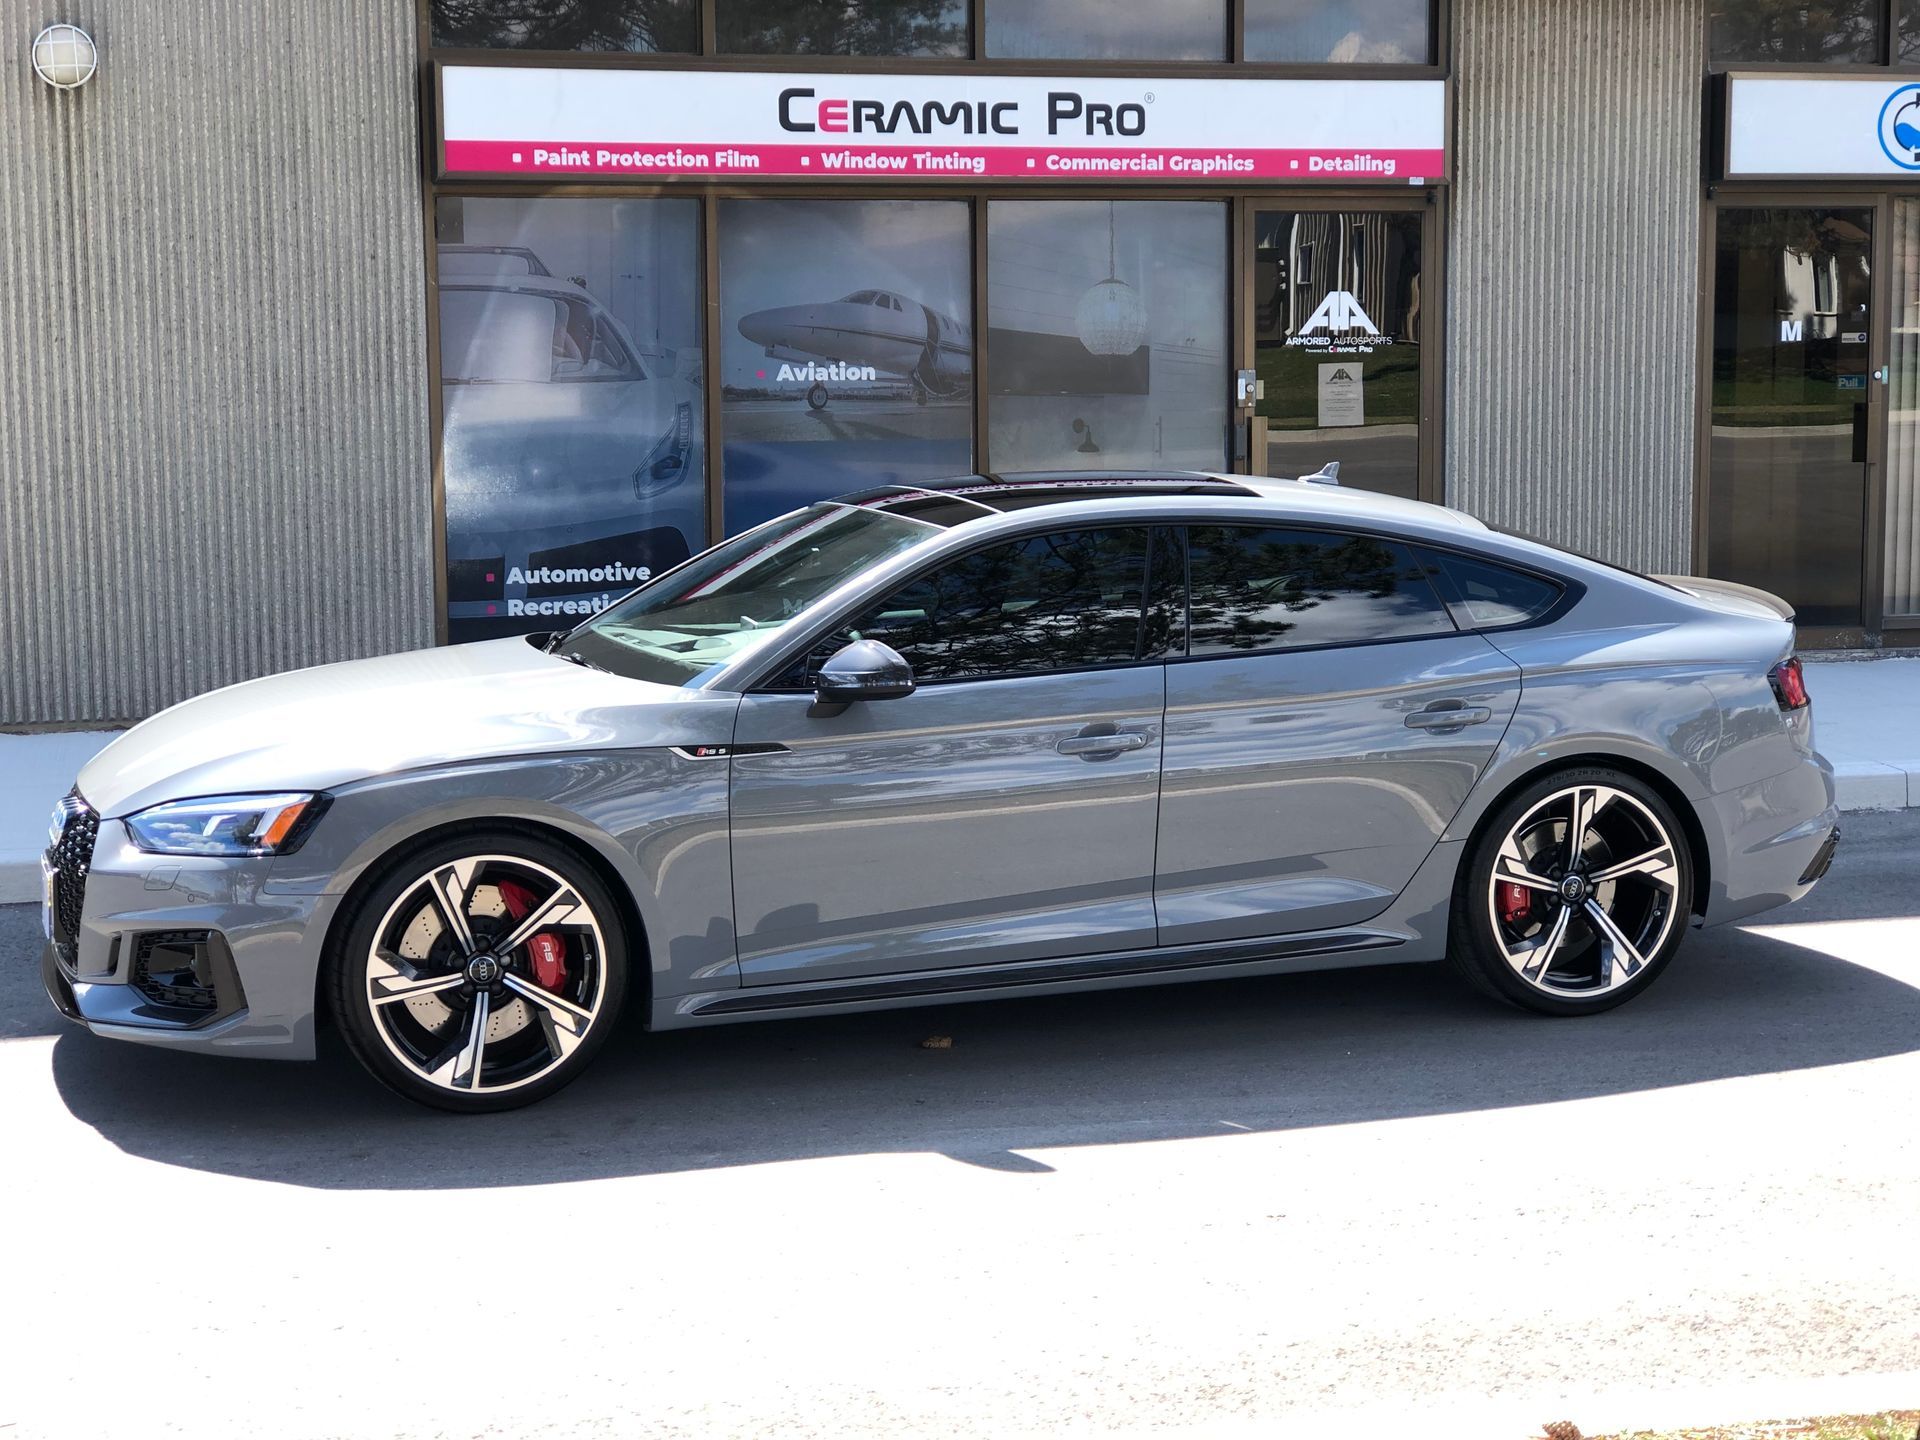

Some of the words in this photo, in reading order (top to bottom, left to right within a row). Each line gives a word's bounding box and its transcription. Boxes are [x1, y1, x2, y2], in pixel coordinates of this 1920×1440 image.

[779, 88, 1018, 134] CERAMIC
[1047, 91, 1146, 137] PRO
[533, 149, 590, 167] Paint
[597, 149, 709, 168] Protection
[716, 150, 760, 168] Film
[821, 152, 908, 169] Window
[913, 153, 986, 174] Tinting
[1045, 153, 1164, 172] Commercial
[1170, 154, 1255, 175] Graphics
[1309, 154, 1396, 175] Detailing
[1286, 337, 1331, 345] ARMORED
[1333, 336, 1393, 345] AUTOSPORTS
[1781, 320, 1802, 341] M
[776, 361, 876, 381] Aviation
[1838, 377, 1859, 388] Pull
[506, 562, 652, 585] Automotive
[541, 942, 554, 962] RS
